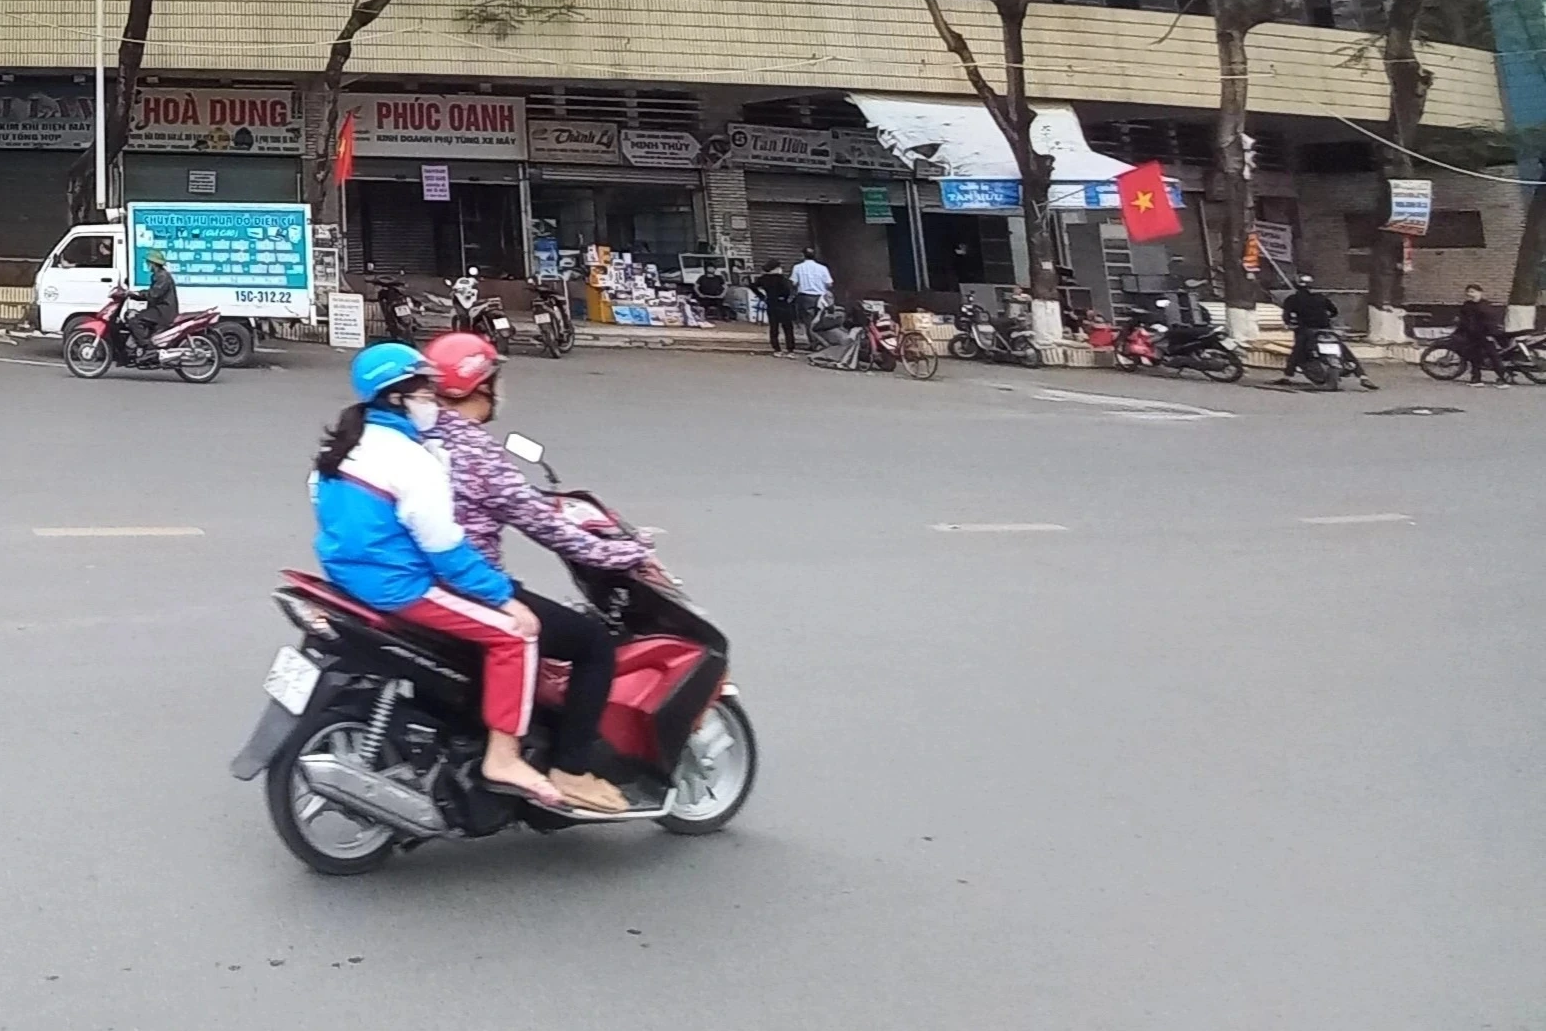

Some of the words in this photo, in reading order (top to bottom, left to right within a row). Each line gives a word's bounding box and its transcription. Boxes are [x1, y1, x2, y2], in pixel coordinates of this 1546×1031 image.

[137, 92, 200, 129] HOÀ
[209, 98, 292, 127] DUNG
[376, 97, 442, 130] PHÚC
[448, 102, 515, 132] OANH
[186, 215, 207, 226] THU
[209, 215, 232, 226] MUA
[235, 290, 292, 304] 15C-312.22
